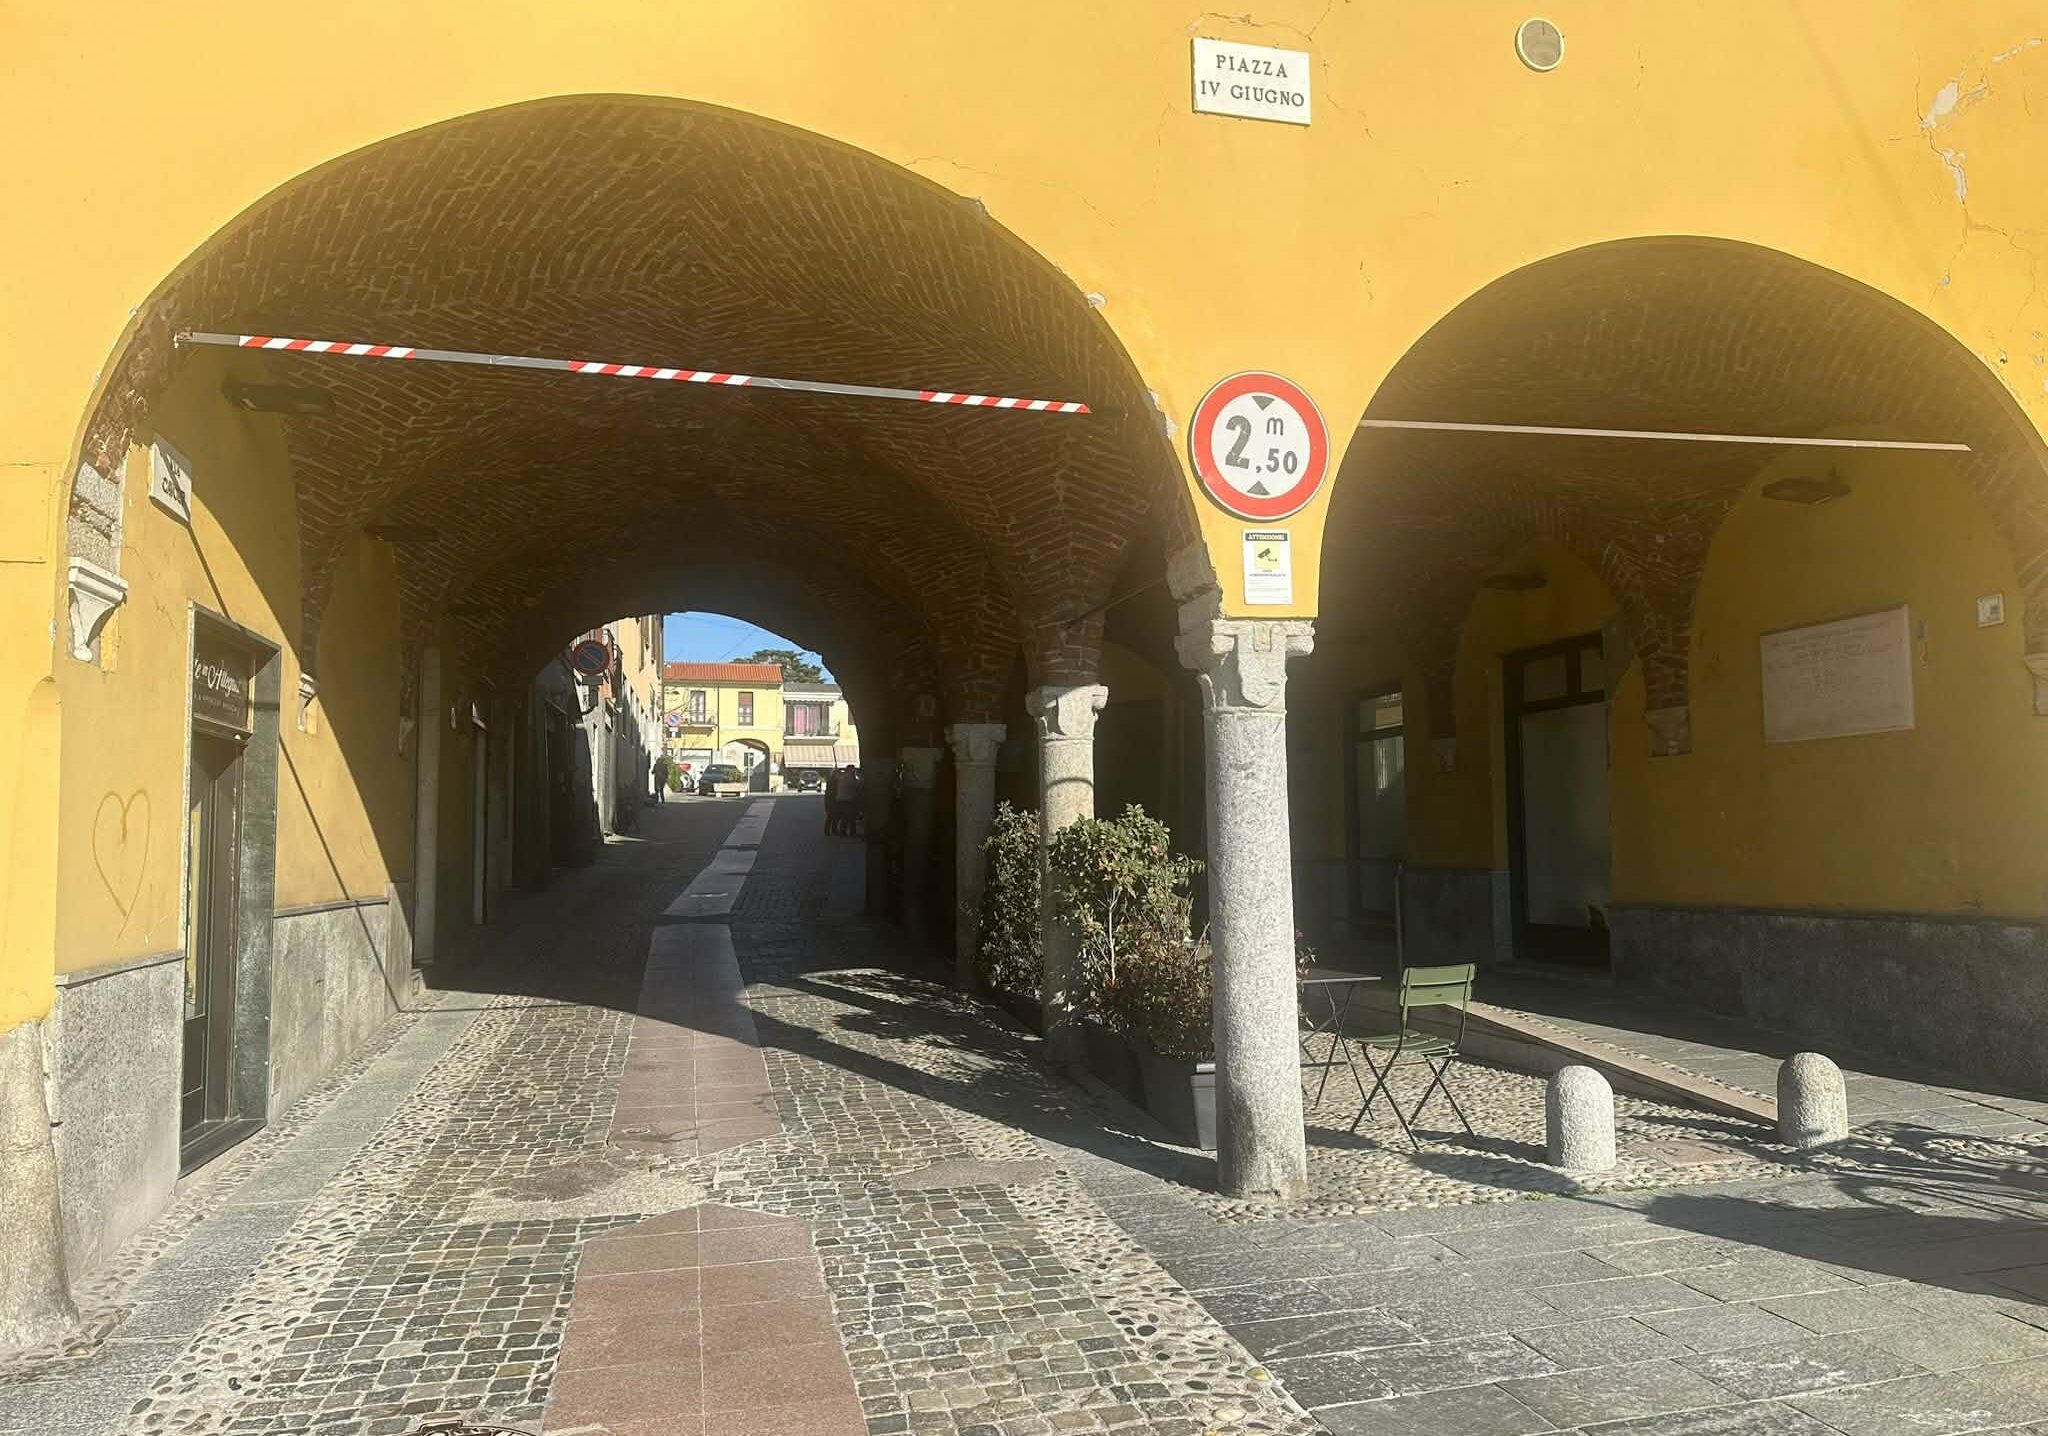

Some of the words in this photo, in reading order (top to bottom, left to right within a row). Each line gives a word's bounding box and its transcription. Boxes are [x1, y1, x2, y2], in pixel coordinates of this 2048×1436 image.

[1216, 54, 1288, 78] PIAZZA
[1201, 80, 1221, 96] IV
[1230, 85, 1305, 107] GIUGNO
[1266, 416, 1284, 436] m
